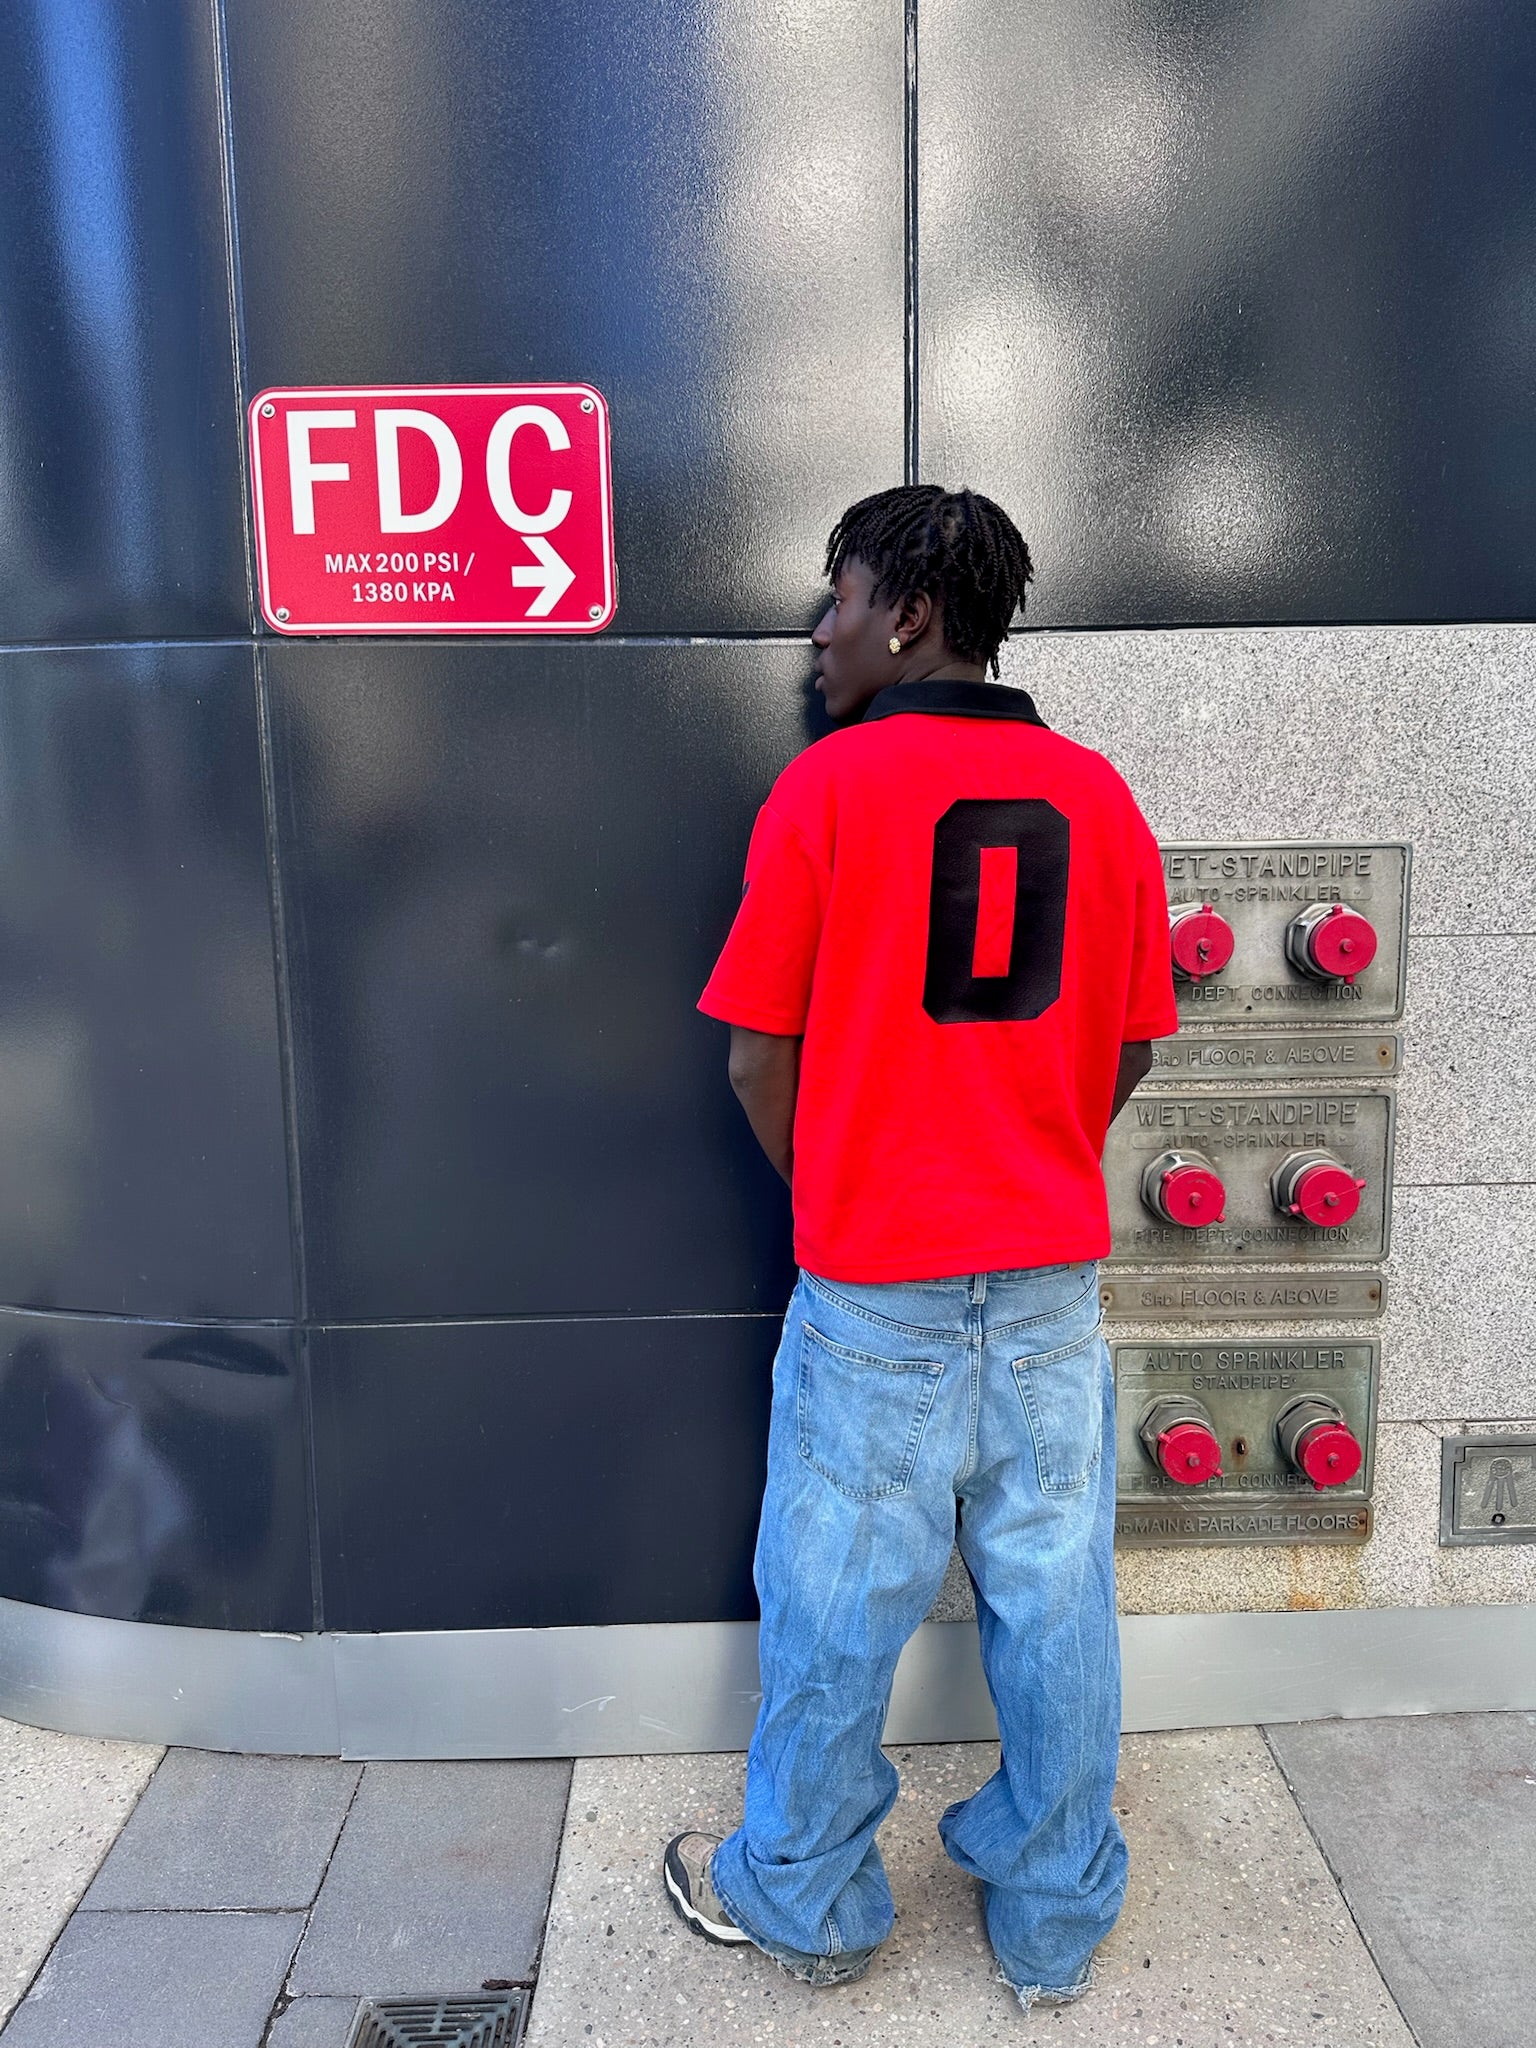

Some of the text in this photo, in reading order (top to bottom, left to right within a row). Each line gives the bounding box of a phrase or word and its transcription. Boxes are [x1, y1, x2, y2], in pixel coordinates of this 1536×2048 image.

[286, 404, 573, 535] FDC
[325, 553, 372, 574] MAX
[376, 553, 419, 573] 200
[424, 553, 459, 573] PSI
[352, 581, 455, 603] 1380 KPA
[1161, 853, 1372, 879] ET-STANDPIPE
[922, 798, 1070, 1025] 0
[1251, 984, 1364, 1001] CONNECTION
[1187, 1048, 1257, 1066] FLOOR
[1264, 1047, 1281, 1064] &
[1285, 1045, 1355, 1063] ABOVE
[1136, 1101, 1357, 1127] WET-STANDPIPE
[1133, 1229, 1173, 1243] FIRE
[1241, 1227, 1350, 1242] CONNECTION
[1141, 1288, 1339, 1307] 3RD FLOOR & ABOVE
[1143, 1350, 1347, 1370] AUTO SPRINKLER
[1192, 1374, 1292, 1391] STANDPIPE
[1130, 1475, 1172, 1489] FIRE
[1134, 1518, 1180, 1536] MAIN
[1183, 1518, 1196, 1534] &
[1198, 1514, 1282, 1534] PARKADE
[1286, 1513, 1361, 1532] FLOORS
